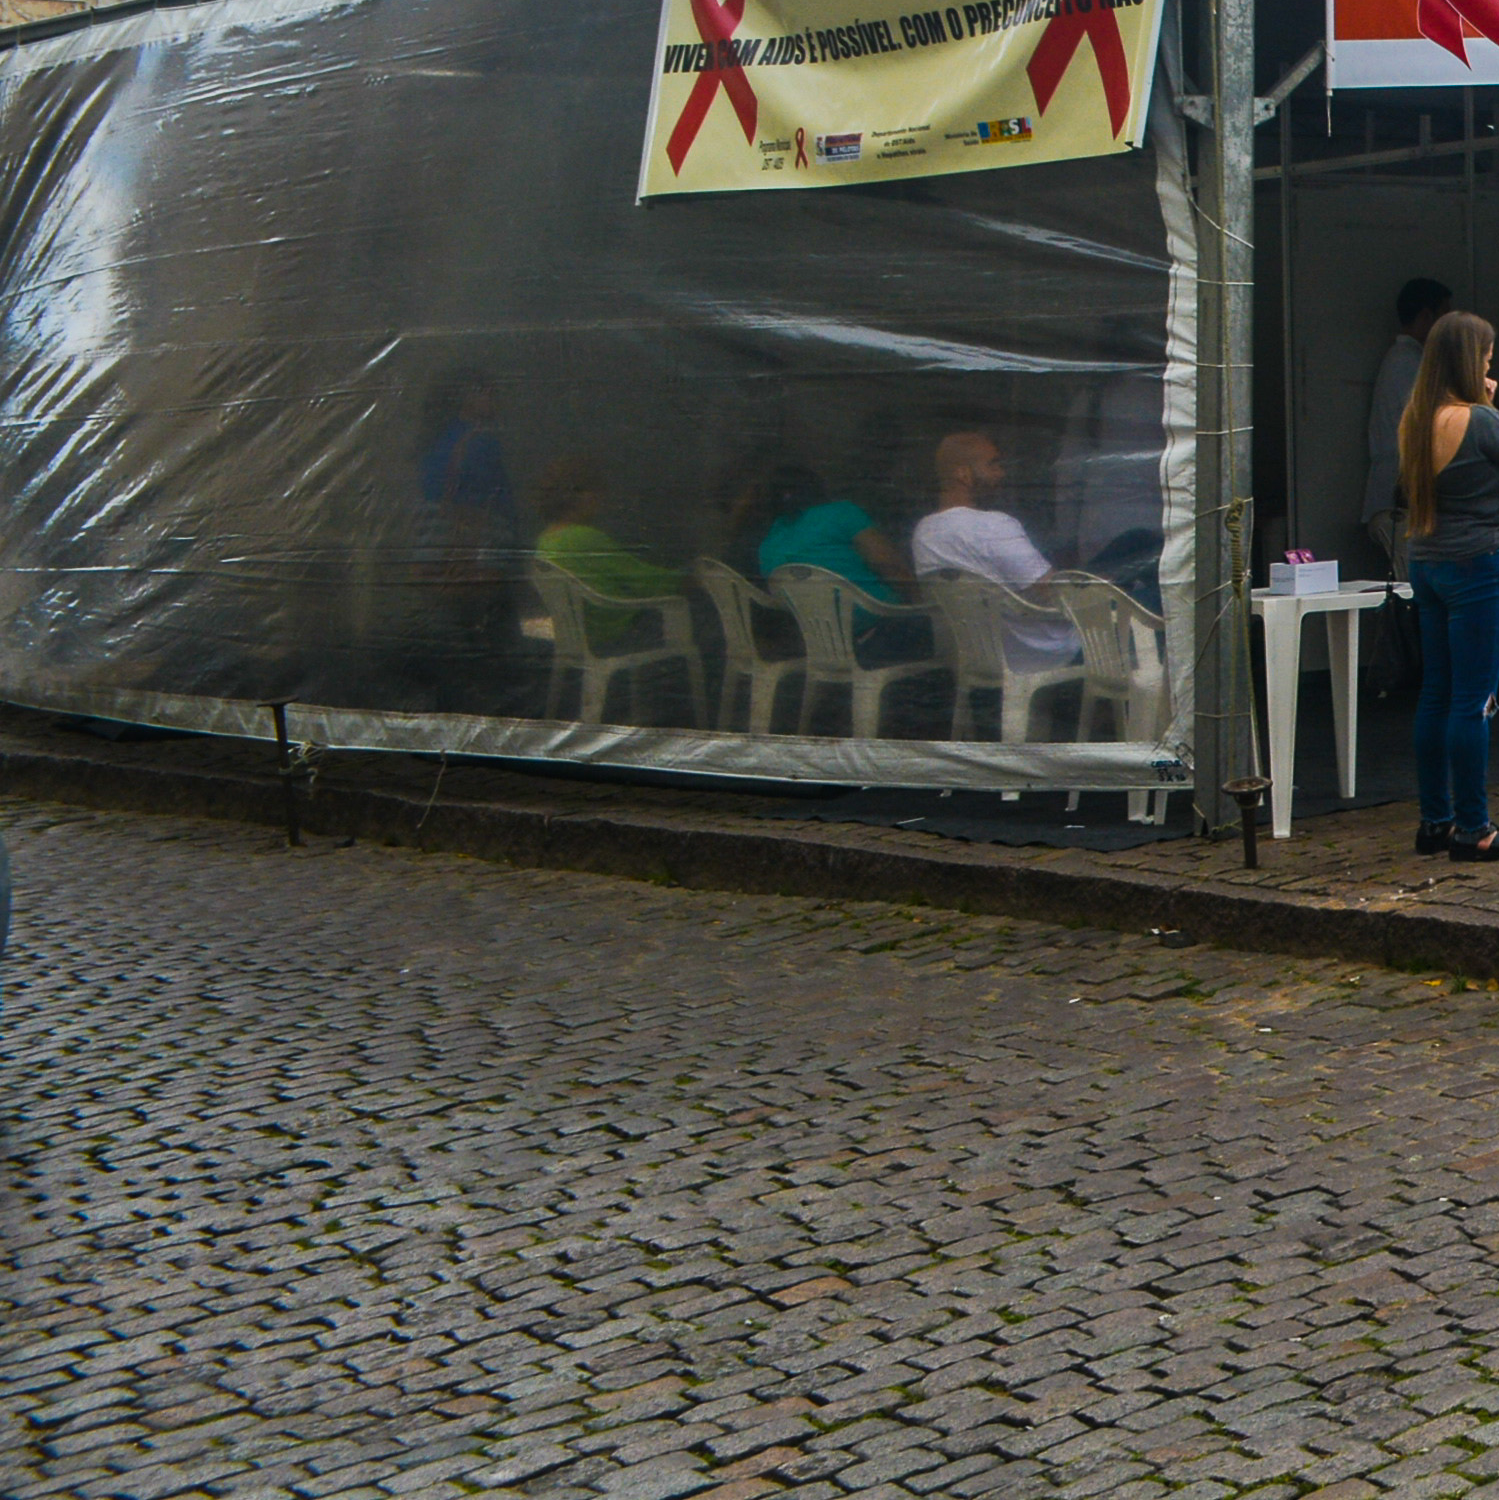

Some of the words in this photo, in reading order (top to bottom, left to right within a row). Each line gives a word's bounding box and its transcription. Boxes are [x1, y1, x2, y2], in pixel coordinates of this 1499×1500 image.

[663, 43, 714, 74] VIVER
[718, 38, 764, 71] COM
[757, 35, 807, 66] AIDS
[805, 27, 818, 63] É
[899, 11, 948, 49] COM
[946, 7, 964, 41] O
